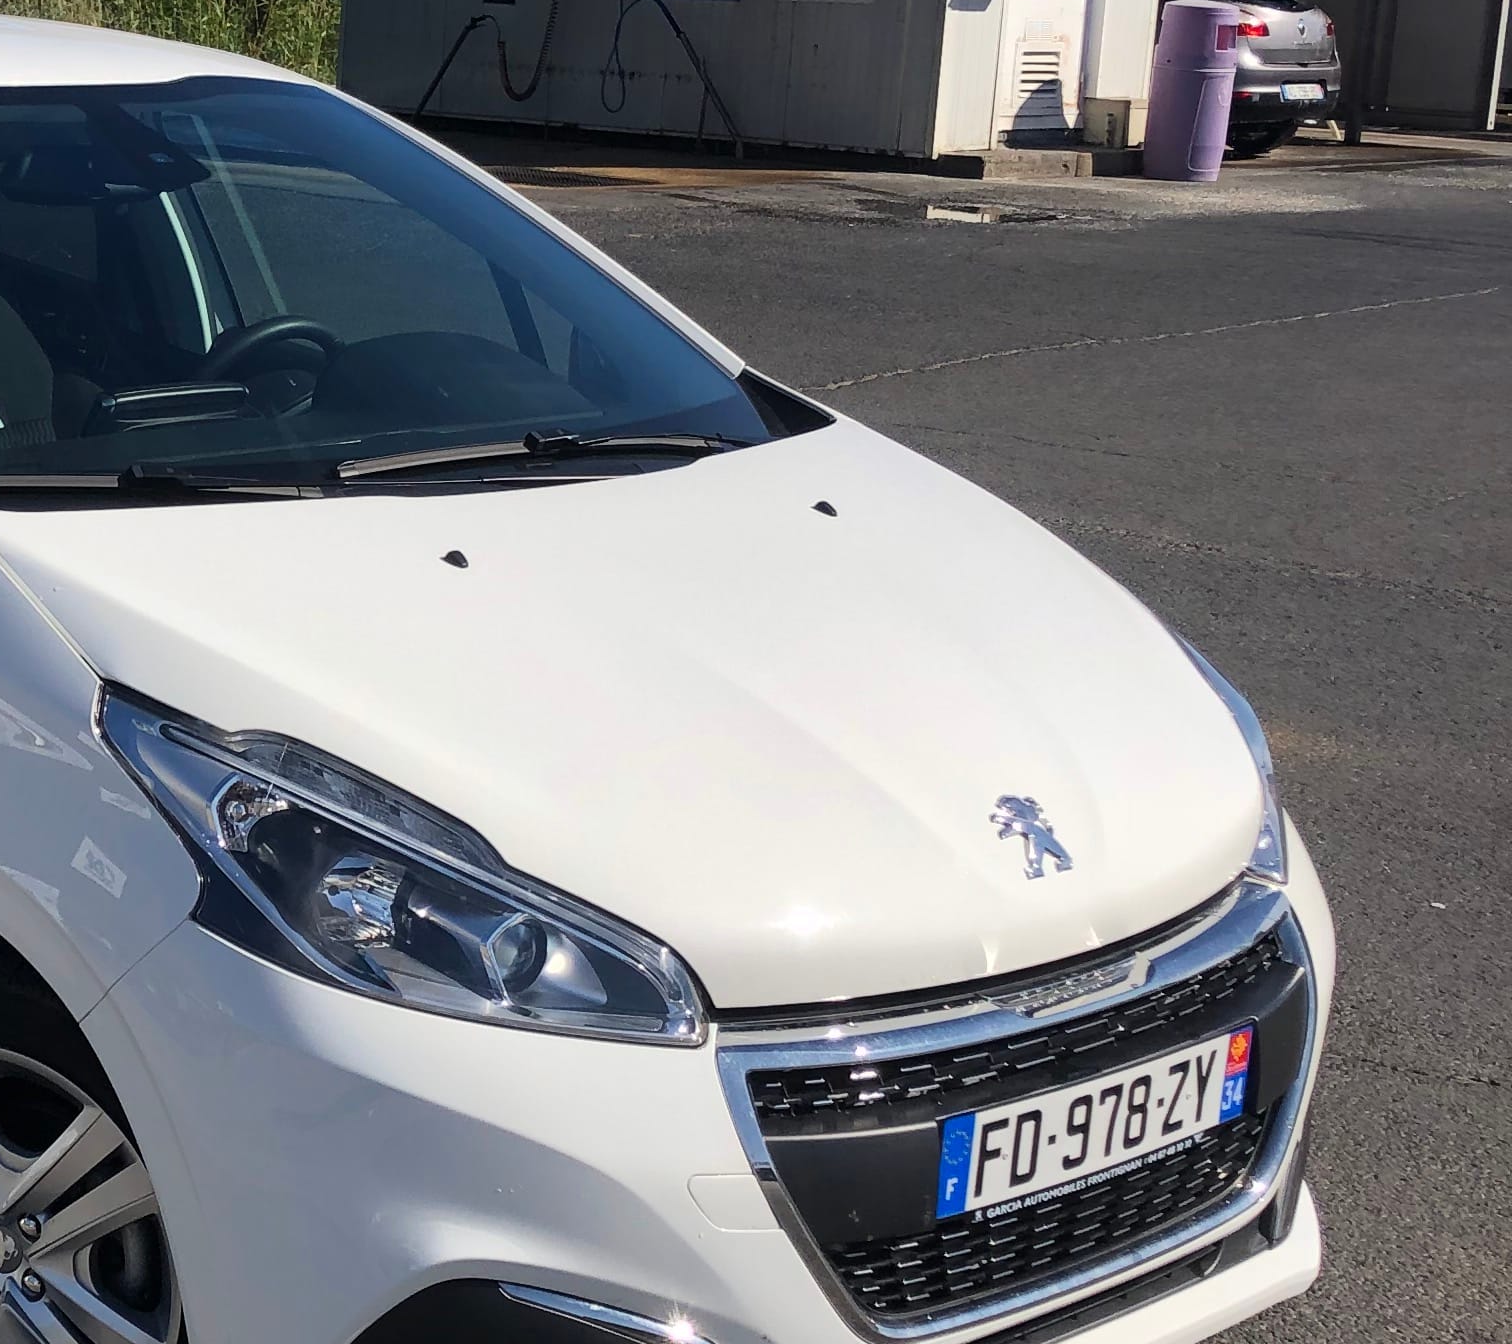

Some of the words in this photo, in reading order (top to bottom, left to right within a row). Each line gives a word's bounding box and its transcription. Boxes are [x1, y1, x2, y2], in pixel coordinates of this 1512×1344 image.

[1222, 1077, 1243, 1110] 34
[974, 1050, 1216, 1197] FD-978-ZY
[945, 1178, 959, 1201] F
[986, 1200, 1023, 1219] GARCIA
[1024, 1179, 1087, 1206] AUTOMOBILES
[1087, 1159, 1143, 1186] FRONTIGNAN
